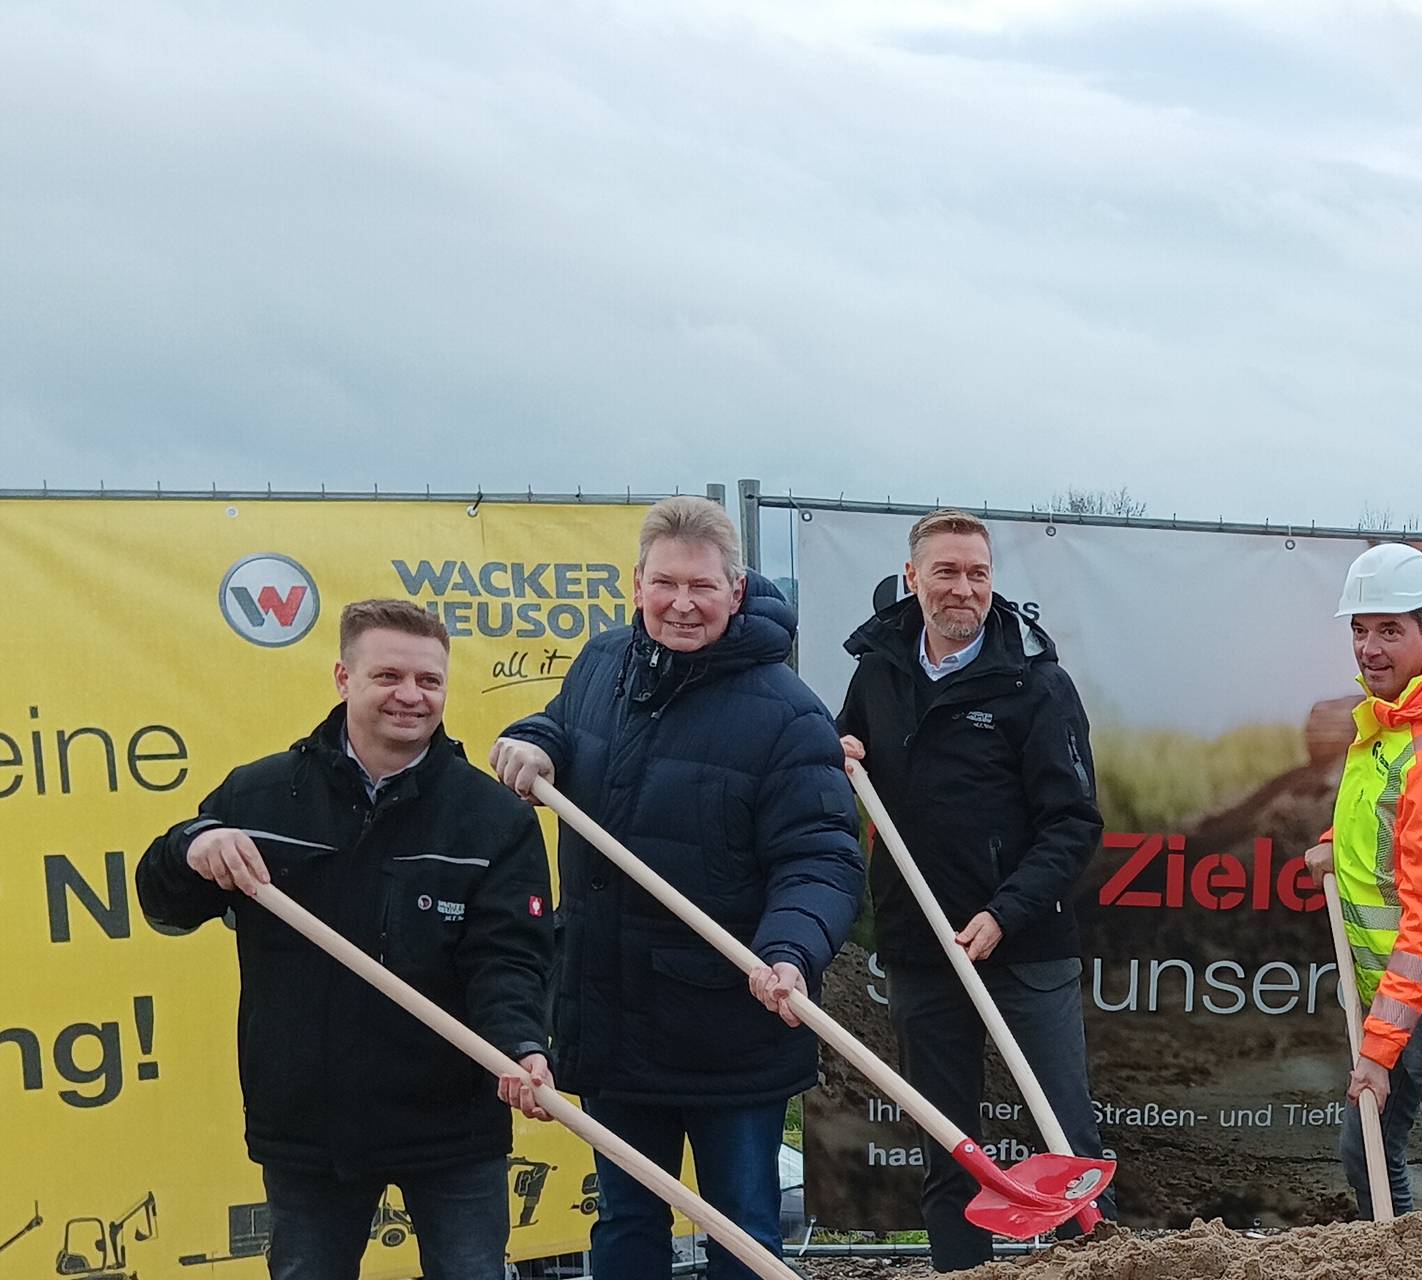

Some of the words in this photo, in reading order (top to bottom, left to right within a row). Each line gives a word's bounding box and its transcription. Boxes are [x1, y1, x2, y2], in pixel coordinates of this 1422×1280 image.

[391, 560, 625, 599] WACKER
[493, 651, 527, 678] all
[540, 649, 572, 675] it
[1093, 957, 1348, 1014] unser
[1220, 1104, 1272, 1127] und
[1283, 1102, 1344, 1126] Tiefb
